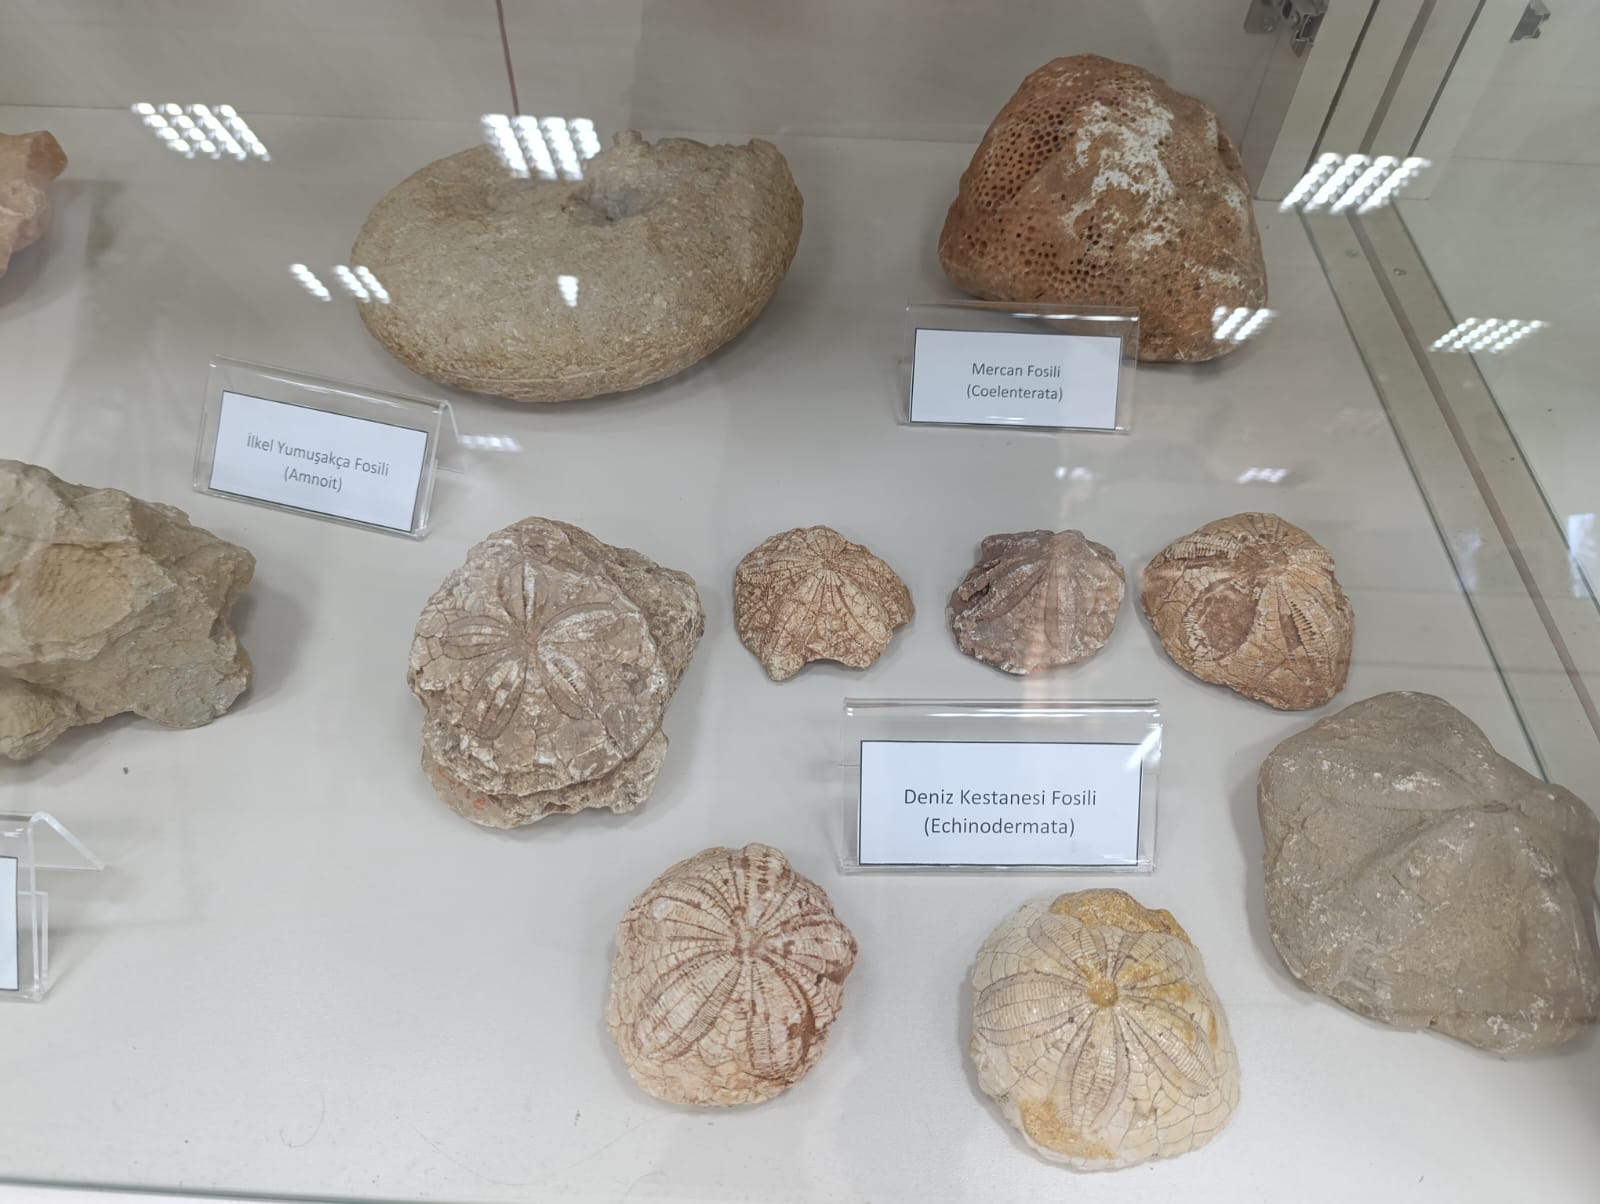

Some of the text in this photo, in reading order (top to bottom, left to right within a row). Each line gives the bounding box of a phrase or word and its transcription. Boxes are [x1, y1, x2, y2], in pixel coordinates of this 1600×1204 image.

[972, 362, 1061, 378] Mercan Fosili
[966, 383, 1063, 402] (Coelenterata)
[246, 432, 390, 477] İlkel Yumuşakça Fosili
[284, 466, 343, 493] (Amnoit)
[904, 788, 1098, 807] Deniz Kestanesi Fosili
[924, 816, 1076, 838] (Echinodermata)
